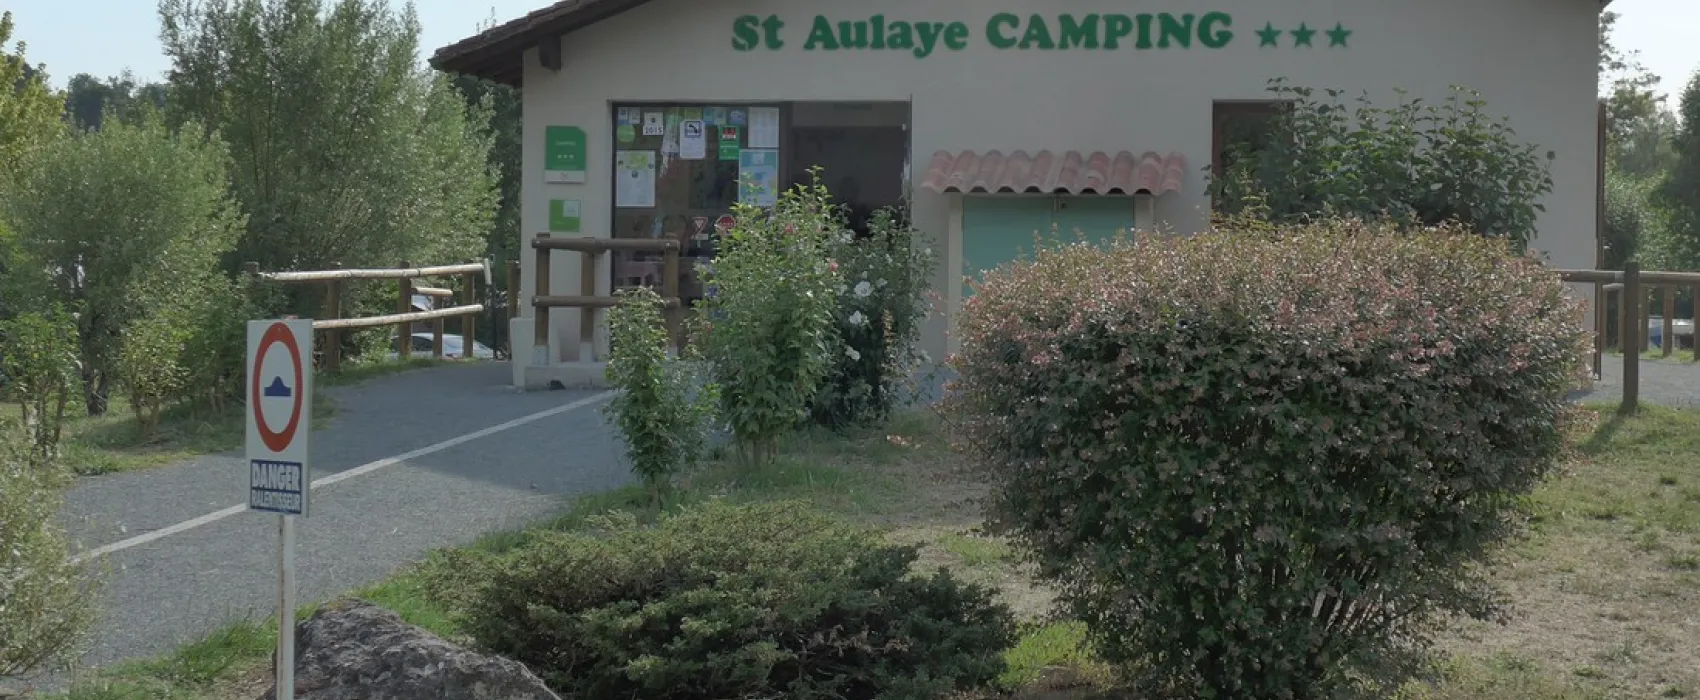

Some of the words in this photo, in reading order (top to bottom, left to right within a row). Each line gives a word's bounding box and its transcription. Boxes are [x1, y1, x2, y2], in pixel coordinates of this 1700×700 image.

[731, 14, 785, 51] St
[803, 13, 970, 59] Aulaye
[986, 12, 1235, 50] CAMPING
[251, 462, 300, 491] DANGER
